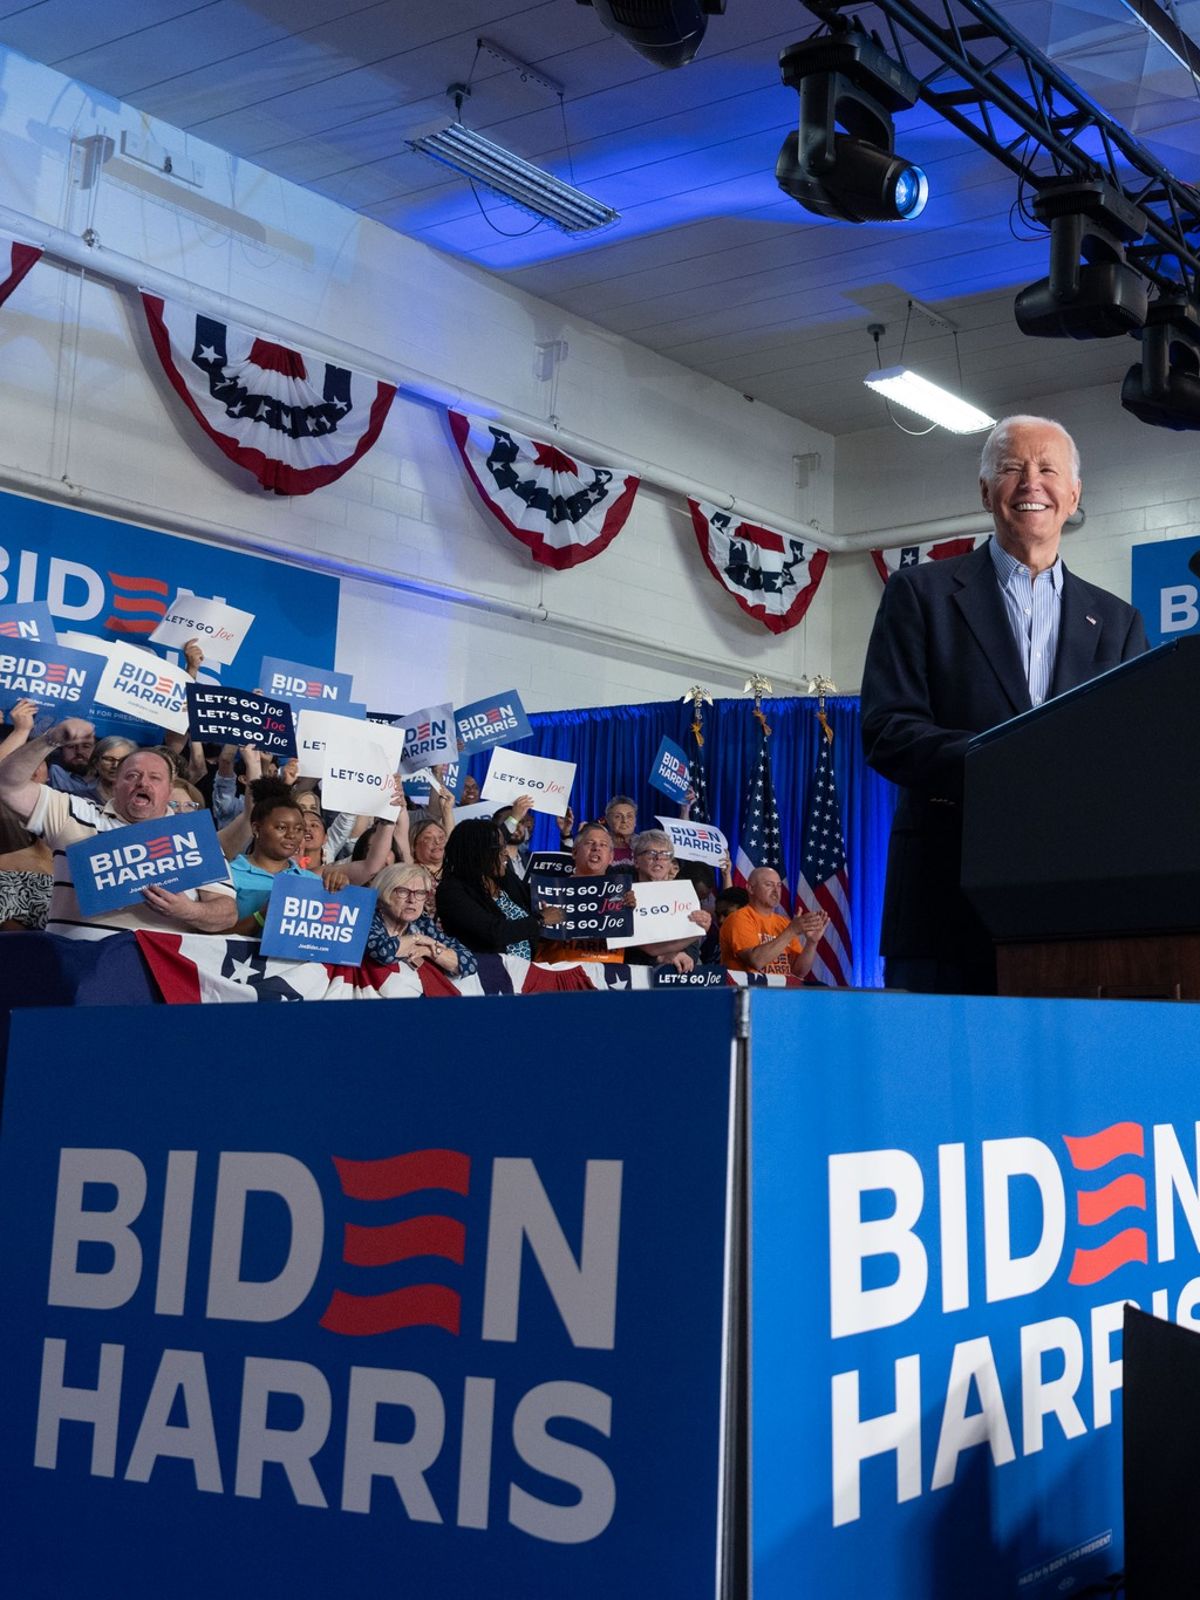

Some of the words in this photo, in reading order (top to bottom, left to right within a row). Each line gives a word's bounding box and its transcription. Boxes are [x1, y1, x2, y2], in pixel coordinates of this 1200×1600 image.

[165, 614, 193, 629] LET'S
[196, 622, 214, 635] GO
[211, 627, 235, 641] Joe
[0, 655, 87, 688] BIDEN
[119, 661, 187, 700] BIDEN
[0, 673, 81, 702] HARRIS
[113, 677, 183, 713] HARRIS
[272, 673, 338, 700] BIDEN
[195, 693, 238, 706] LET'S
[239, 699, 260, 711] GO
[260, 702, 284, 717] Joe
[197, 709, 240, 721] LET'S
[241, 714, 262, 725] GO
[263, 717, 286, 732] Joe
[405, 719, 446, 744] DEN
[457, 704, 515, 733] BIDEN
[461, 717, 518, 743] HARRIS
[199, 725, 241, 737] LET'S
[243, 730, 264, 741] GO
[264, 732, 288, 747] Joe
[401, 736, 448, 762] ARRIS
[658, 763, 689, 792] HARRIS
[662, 751, 690, 781] BIDEN
[331, 768, 364, 783] LET'S
[366, 775, 382, 787] GO
[380, 774, 396, 791] Jo
[493, 771, 526, 786] LET'S
[527, 779, 544, 789] GO
[543, 780, 565, 794] Joe
[89, 831, 198, 875] BIDEN
[673, 834, 722, 855] HARRIS
[94, 850, 203, 891] HARRIS
[533, 861, 563, 872] LET'S
[129, 876, 179, 894] JoeBen.com
[538, 885, 575, 896] LET'S
[577, 885, 598, 896] GO
[598, 881, 624, 897] Joe
[283, 896, 360, 926] BIDEN
[577, 902, 598, 912] GO
[598, 897, 624, 915] Joe
[651, 904, 670, 915] GO
[671, 900, 692, 916] Joe
[279, 918, 354, 943] HARRIS
[577, 919, 598, 929] GO
[598, 915, 624, 931] Joe
[659, 974, 688, 984] LET'S
[690, 974, 704, 984] GO
[704, 971, 722, 987] Joe
[47, 1147, 624, 1350] BIDEN
[33, 1336, 617, 1545] HARRIS
